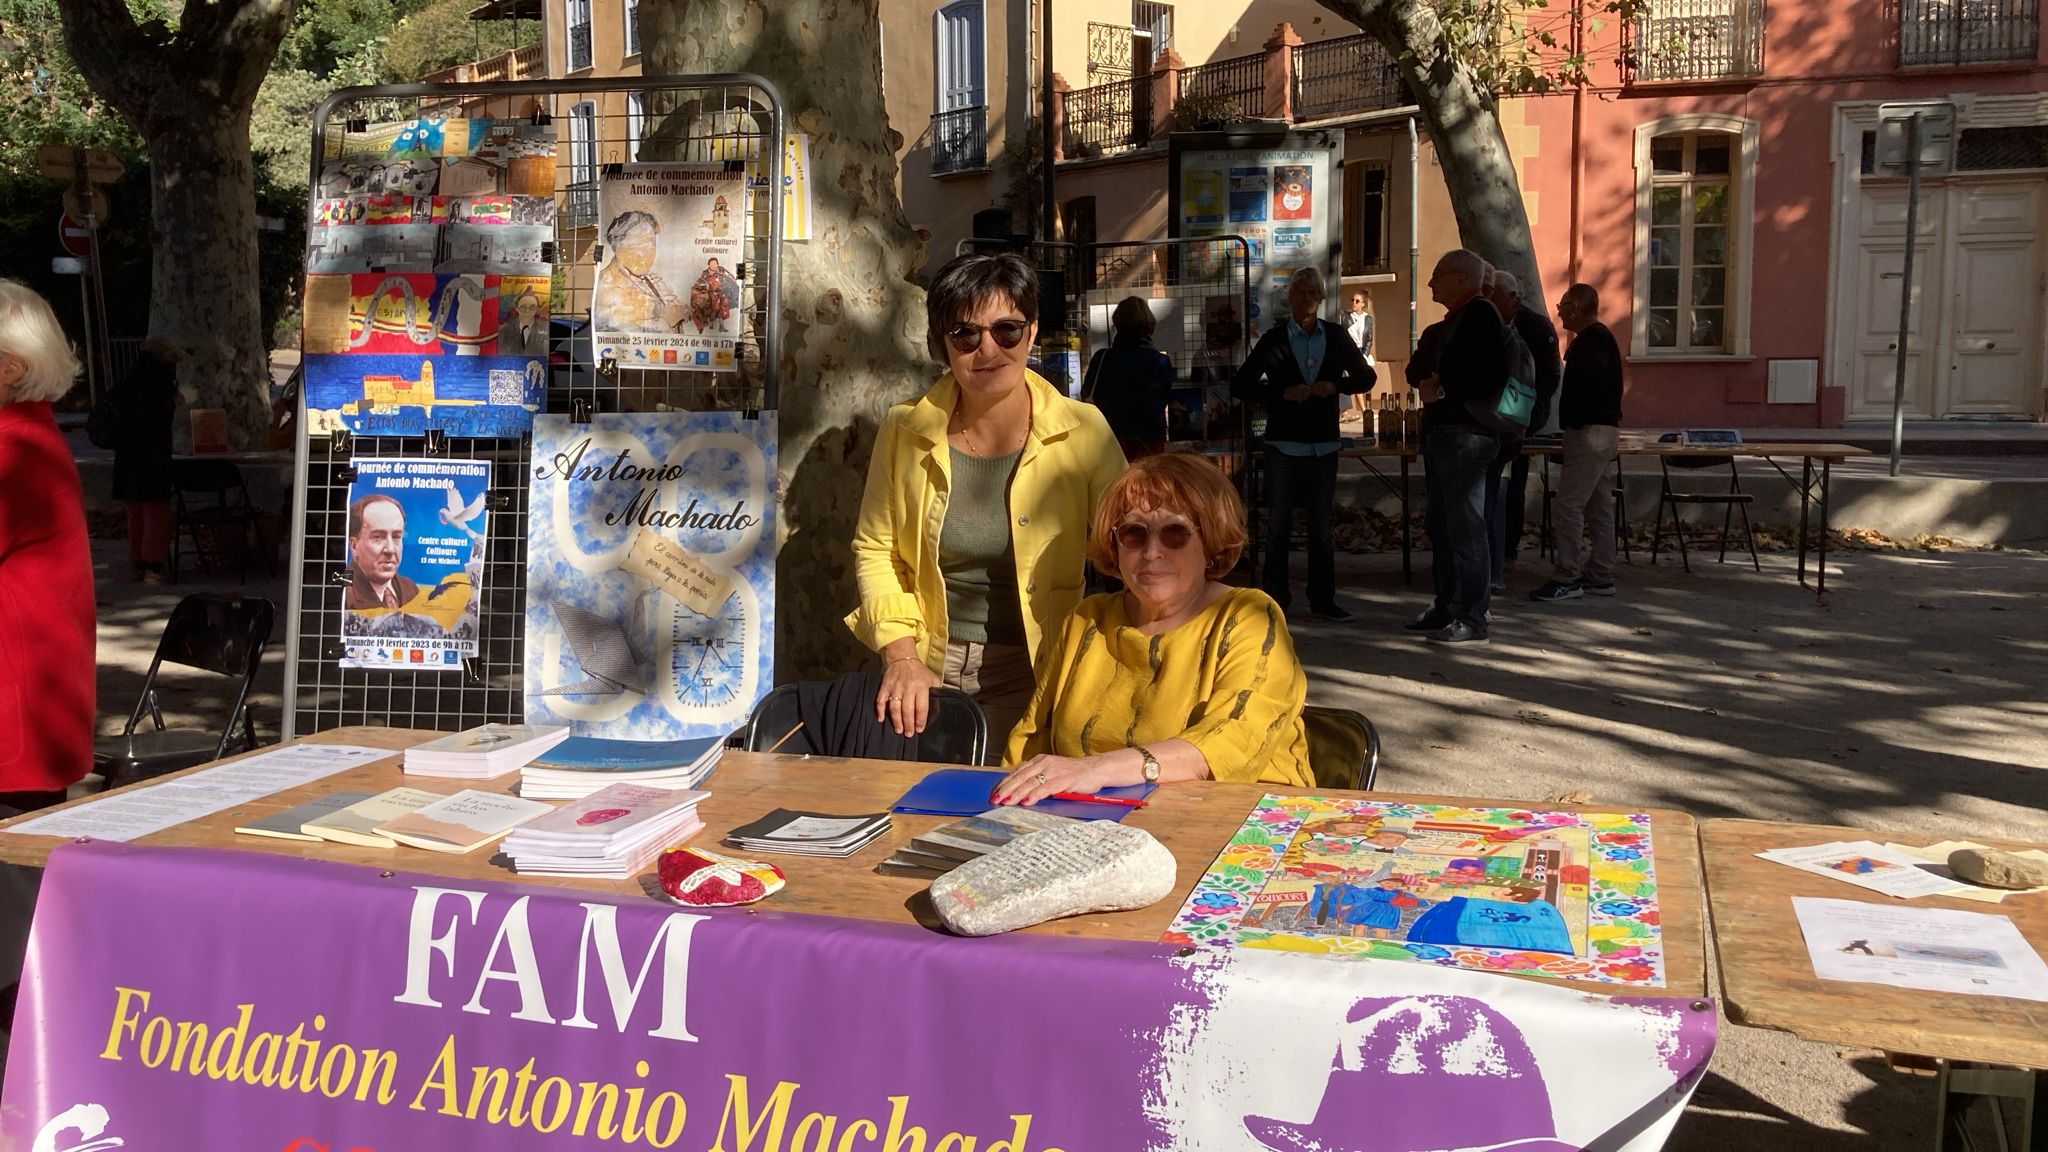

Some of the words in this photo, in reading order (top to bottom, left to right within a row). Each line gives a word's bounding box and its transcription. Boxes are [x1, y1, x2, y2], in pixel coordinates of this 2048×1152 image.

[1262, 151, 1314, 161] ANIMATION
[646, 170, 659, 180] de
[660, 170, 742, 181] commémoration
[630, 184, 668, 195] Antonio
[670, 184, 714, 196] Machado
[695, 238, 714, 246] Centre
[714, 238, 738, 246] culturel
[597, 335, 631, 346] Dimanche
[632, 337, 642, 346] 25
[643, 337, 668, 347] février
[670, 338, 689, 347] 2024
[690, 338, 701, 347] de
[702, 338, 712, 348] 9h
[720, 339, 734, 349] 17h
[535, 437, 689, 482] Antonio
[357, 462, 393, 475] Journée
[394, 463, 406, 474] de
[407, 463, 486, 477] commémoration
[375, 477, 411, 488] Antonio
[412, 478, 455, 490] Machado
[605, 488, 760, 531] Machado
[418, 537, 439, 546] Centre
[440, 537, 468, 547] culturel
[426, 547, 458, 556] Collioure
[438, 557, 461, 565] Michelet
[346, 637, 375, 647] Dimanche
[376, 638, 384, 647] 19
[386, 638, 409, 648] février
[410, 640, 430, 649] 2023
[431, 639, 442, 649] de
[443, 640, 452, 649] 9h
[460, 641, 474, 650] 17h
[462, 797, 479, 805] La
[394, 886, 713, 1043] FAM
[99, 986, 399, 1106] Fondation
[409, 1033, 688, 1149] Antonio
